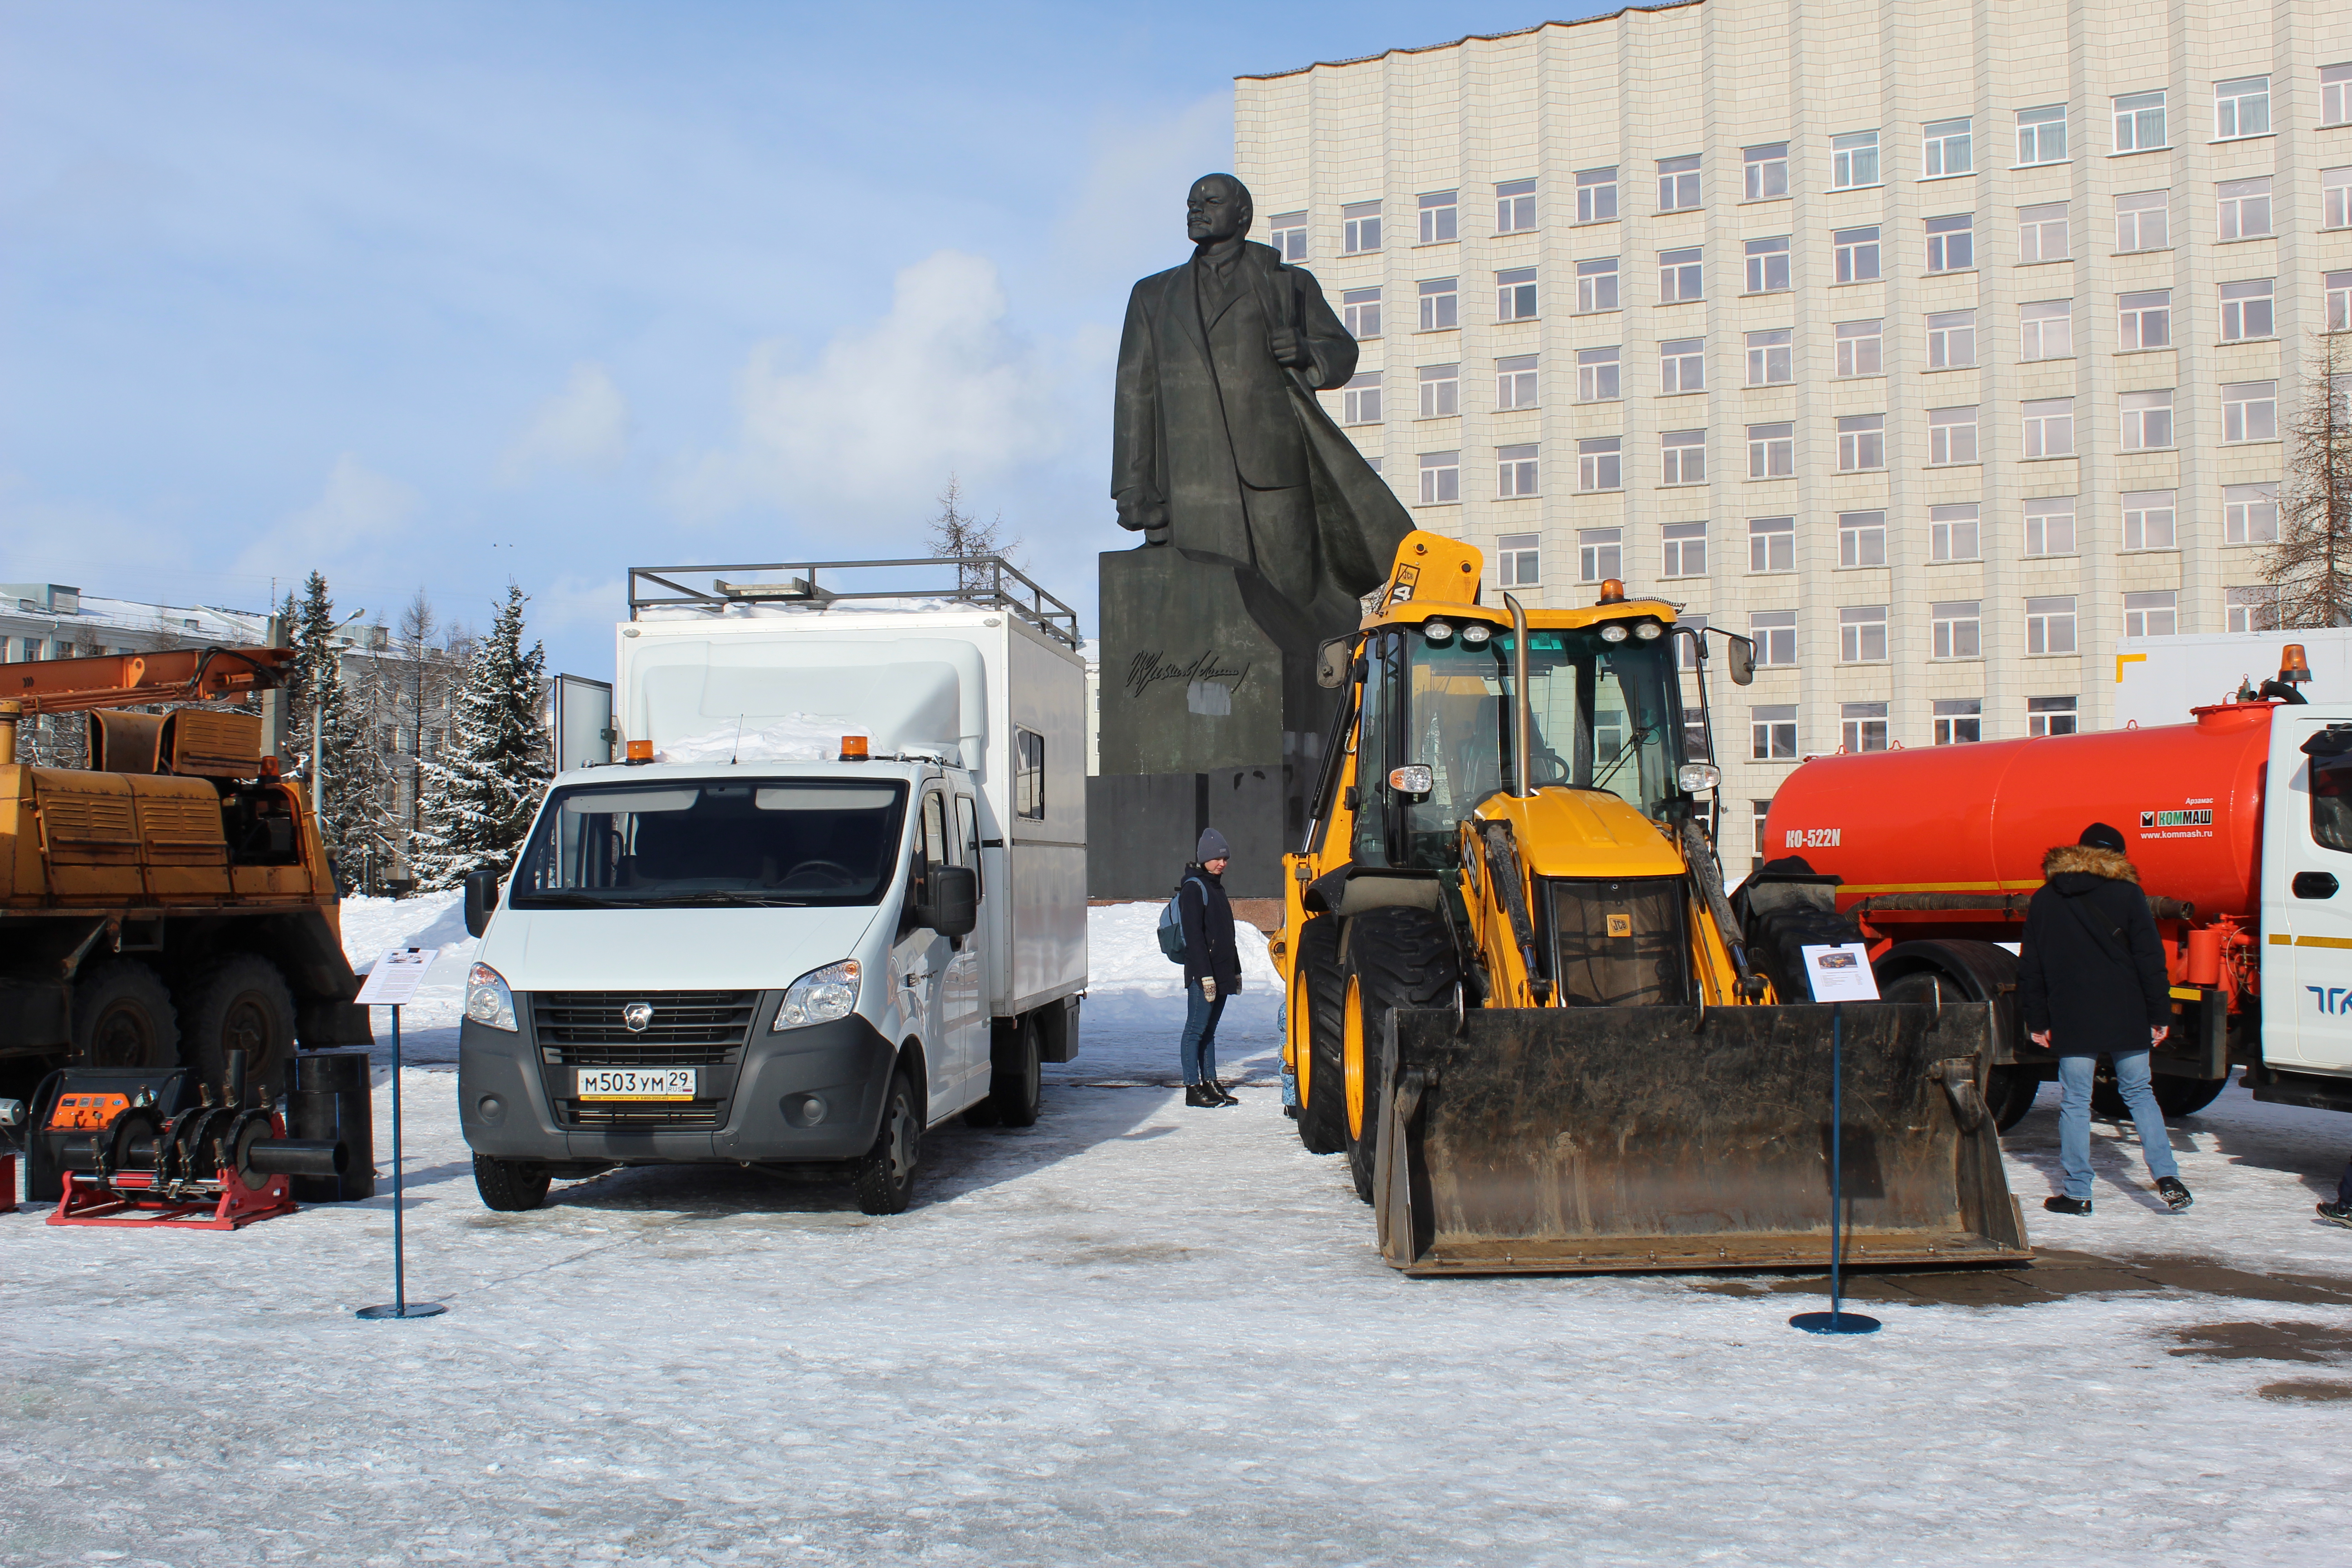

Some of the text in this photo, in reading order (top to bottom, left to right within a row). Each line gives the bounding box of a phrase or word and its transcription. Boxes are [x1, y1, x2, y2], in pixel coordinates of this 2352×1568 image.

[1403, 571, 1413, 579] JCB
[1390, 585, 1411, 605] 4
[2185, 797, 2214, 806] Арзамас
[2158, 809, 2212, 826] КОММАШ
[1785, 828, 1841, 848] КО-522N
[2140, 829, 2213, 839] www.kommash.ru
[1463, 836, 1477, 889] JCB
[1612, 919, 1627, 931] JCB
[669, 1072, 688, 1086] 29
